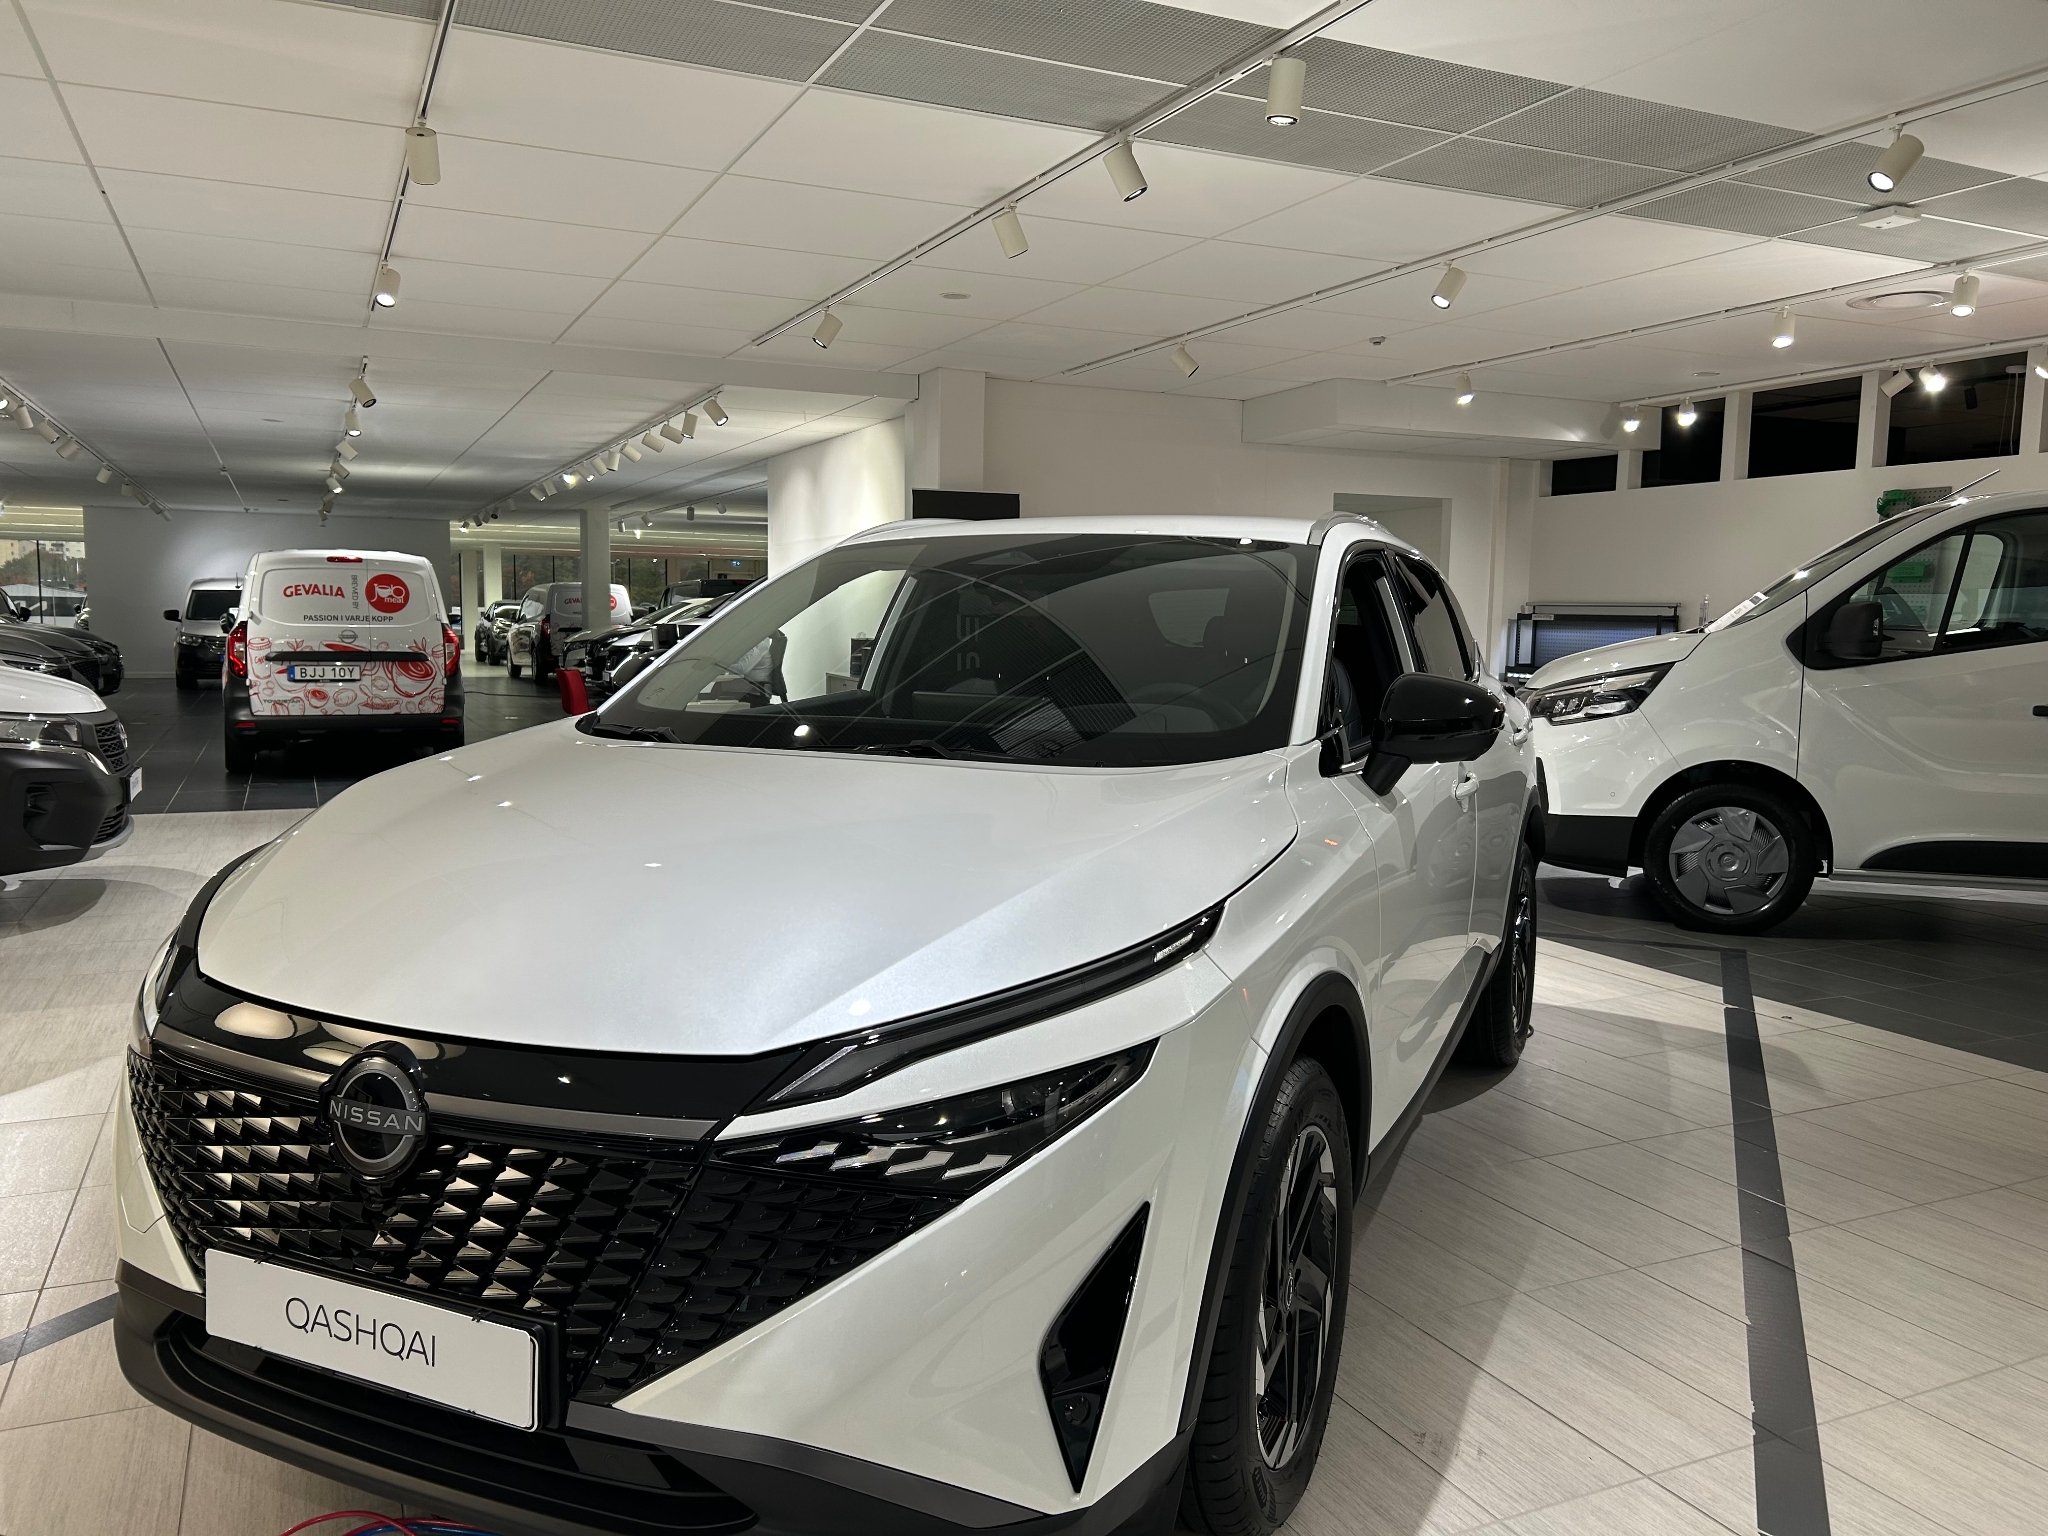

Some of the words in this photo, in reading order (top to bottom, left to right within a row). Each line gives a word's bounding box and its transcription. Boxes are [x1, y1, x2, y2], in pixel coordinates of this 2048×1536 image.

[283, 583, 345, 599] GEVALIA
[351, 574, 359, 600] BREWED
[352, 601, 359, 610] BY
[384, 595, 404, 604] meal
[303, 614, 339, 622] PASSION
[344, 614, 370, 622] VARJE
[371, 615, 394, 623] KOPP
[300, 667, 325, 678] BJJ
[331, 667, 355, 678] 10Y
[329, 1099, 423, 1132] NISSAN
[285, 1296, 437, 1368] QASHQAI
